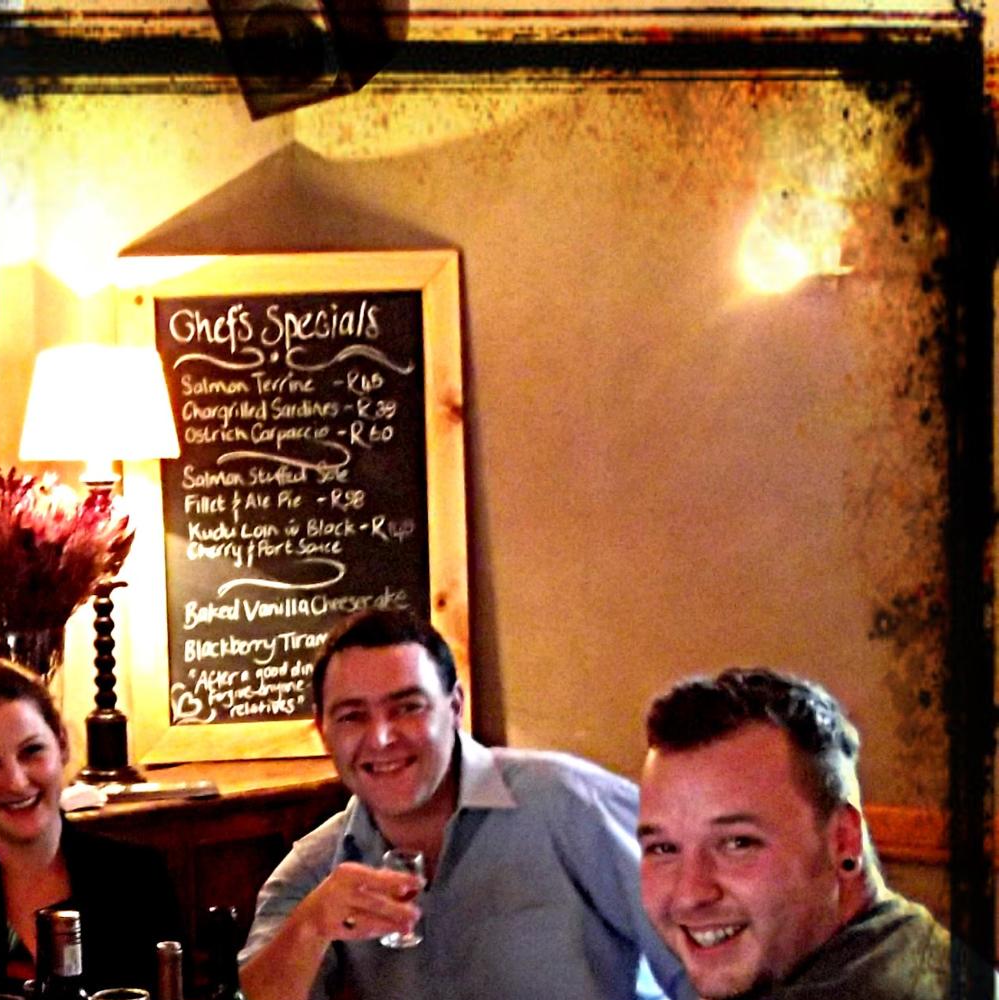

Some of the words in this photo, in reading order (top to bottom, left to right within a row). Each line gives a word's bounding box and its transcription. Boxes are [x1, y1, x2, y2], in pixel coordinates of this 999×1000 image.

[261, 300, 380, 351] Specials
[181, 374, 248, 395] Salmon
[251, 371, 315, 394] Terrine
[271, 397, 339, 418] Sardines
[184, 424, 247, 443] Ostrich
[251, 422, 330, 450] Carpaccio
[182, 464, 244, 489] Salmon
[249, 466, 307, 485] Stuffed
[184, 494, 226, 514] Fillet
[245, 494, 270, 509] Ale
[277, 491, 302, 508] Pie
[187, 521, 236, 541] Kudu
[240, 523, 279, 539] Loin
[186, 541, 242, 568] Cherry
[258, 540, 293, 558] Port
[297, 538, 342, 555] Sauce
[183, 598, 241, 630] Baked
[243, 597, 309, 621] Vanilla
[184, 635, 277, 665] Blackberry
[276, 632, 329, 652] Tiram
[255, 660, 289, 690] good
[290, 659, 315, 678] din
